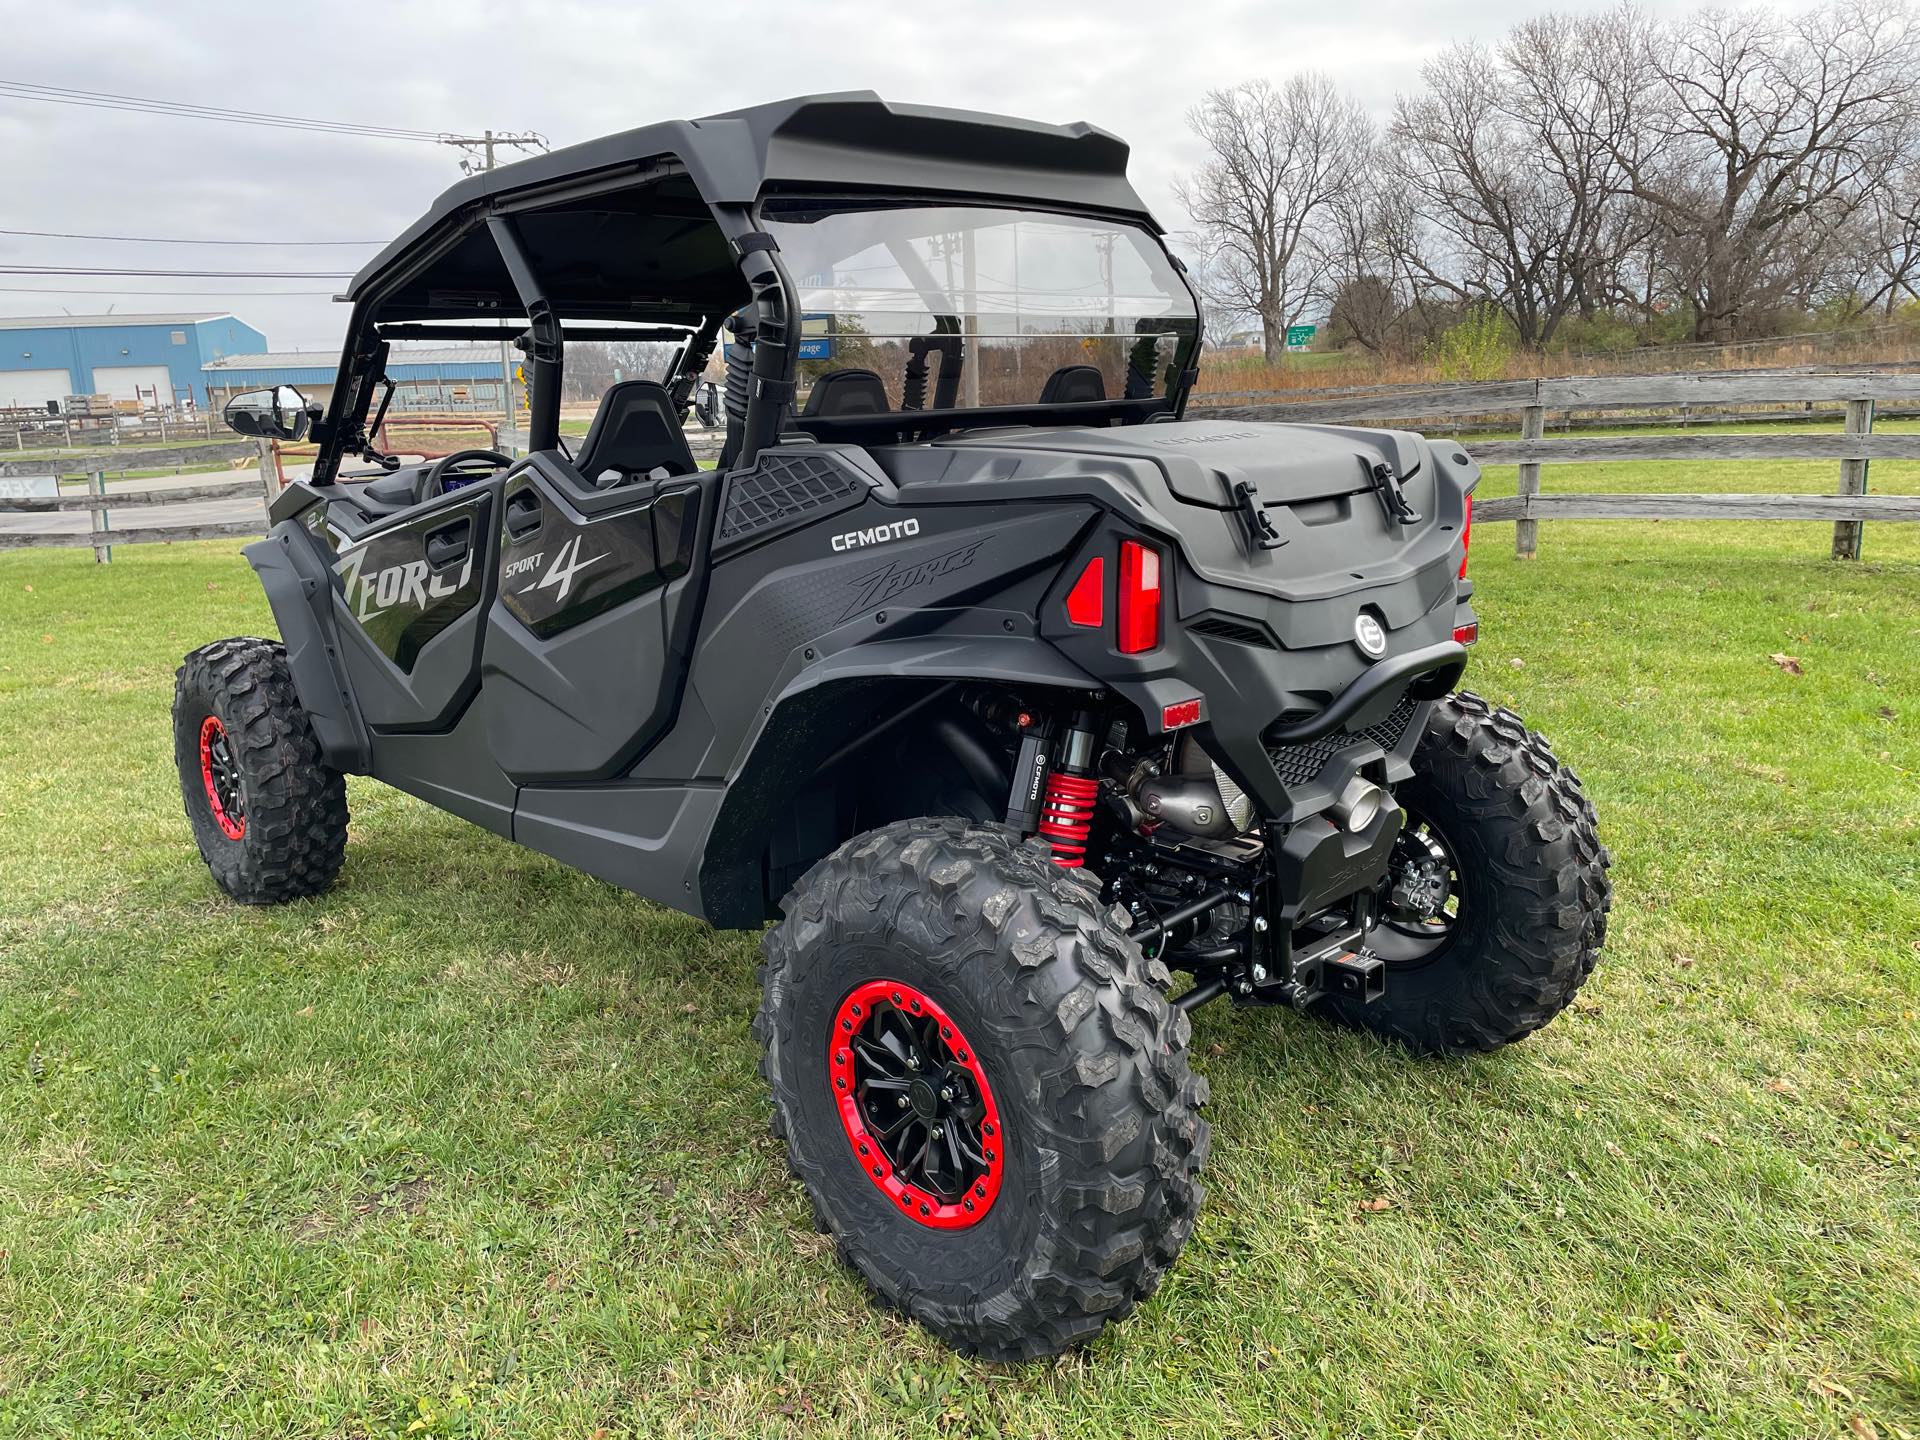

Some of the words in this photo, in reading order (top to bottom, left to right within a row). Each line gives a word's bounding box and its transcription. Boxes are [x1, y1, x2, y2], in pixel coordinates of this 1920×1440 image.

[799, 344, 821, 355] orage
[831, 518, 920, 552] CFMOTO
[505, 552, 544, 579] SPORT
[516, 534, 612, 603] 4
[1030, 765, 1042, 801] CFMOTO
